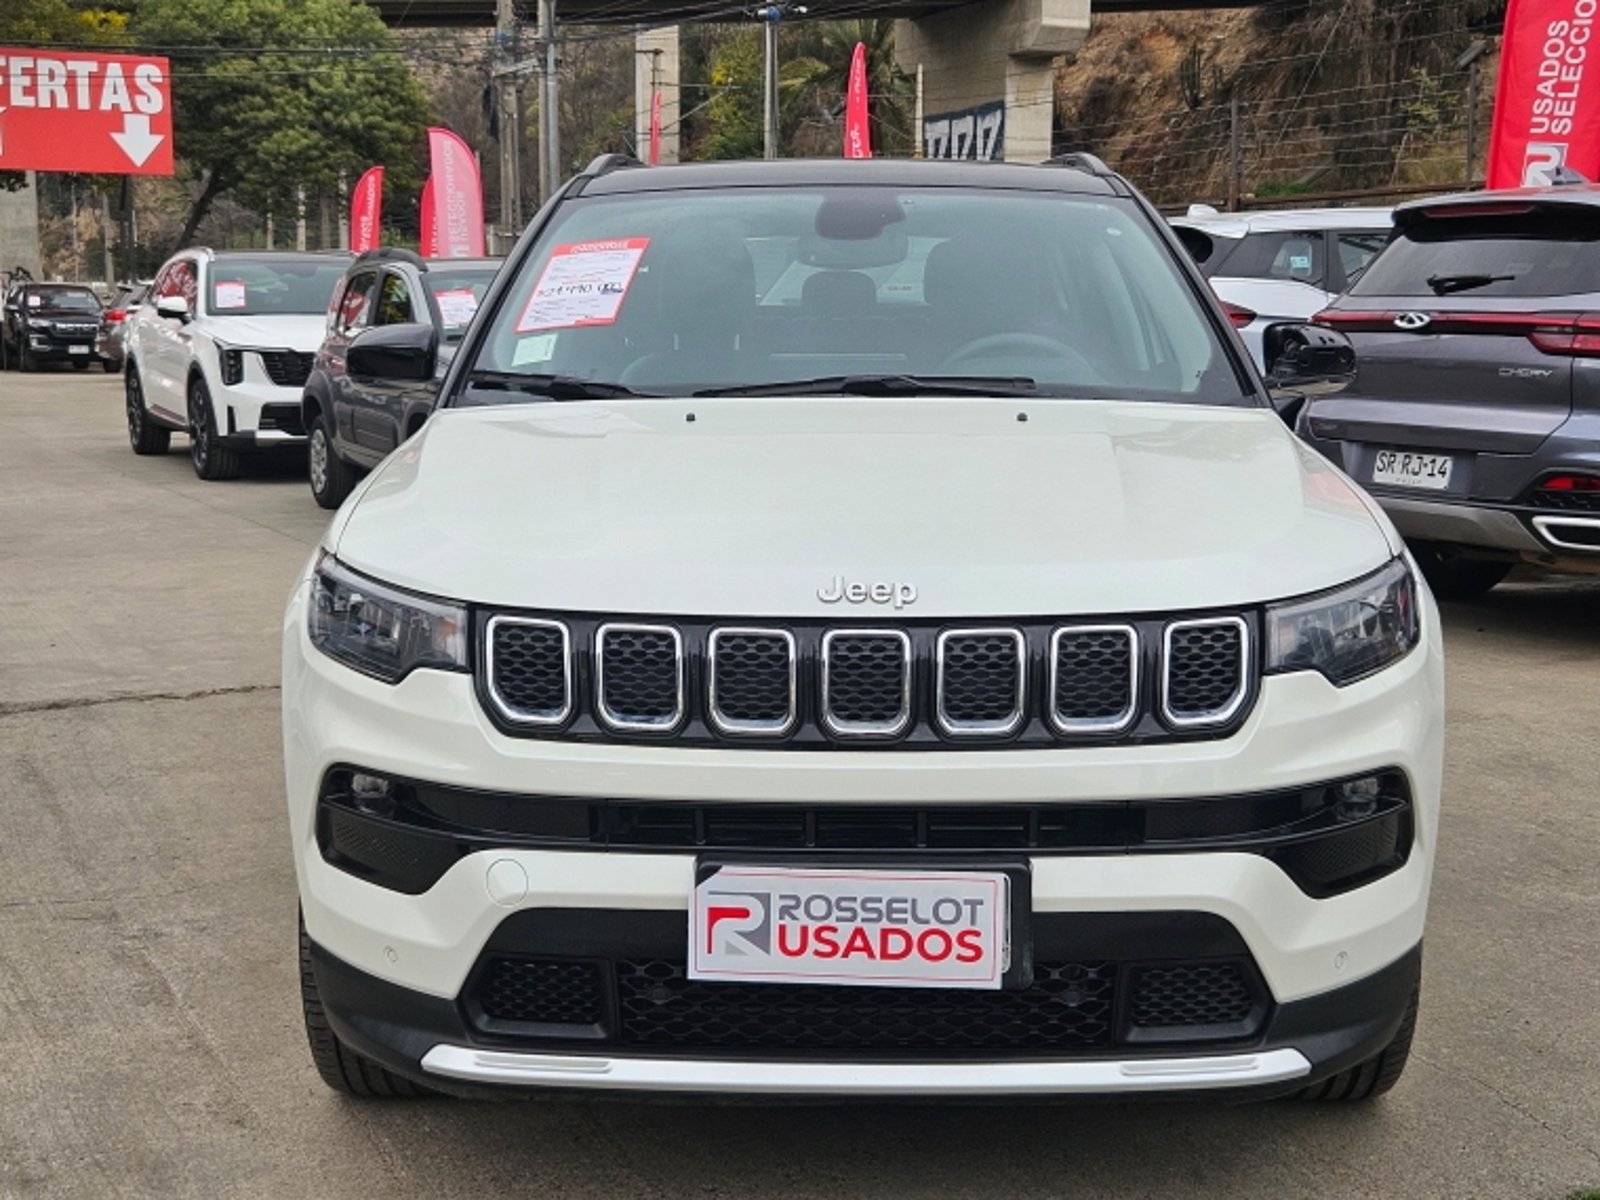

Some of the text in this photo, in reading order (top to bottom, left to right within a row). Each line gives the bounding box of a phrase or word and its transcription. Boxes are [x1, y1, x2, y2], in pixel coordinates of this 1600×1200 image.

[0, 55, 164, 115] ERTAS
[1530, 20, 1569, 134] USADOS
[1551, 0, 1597, 135] SELECCIO
[816, 575, 918, 610] Jeep
[778, 894, 984, 927] ROSSELOT
[778, 923, 985, 963] USADOS
